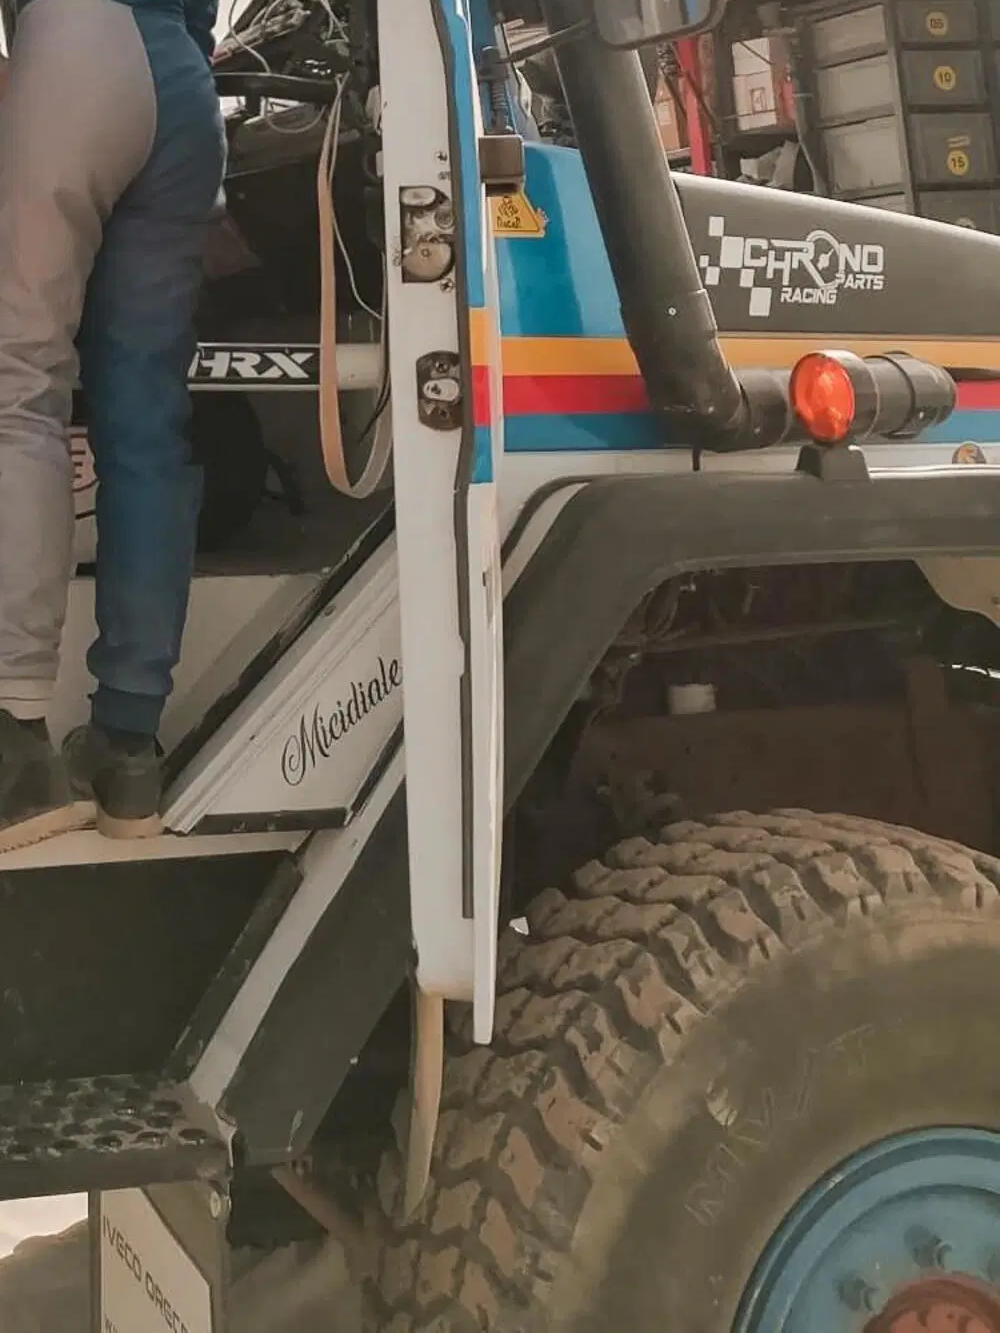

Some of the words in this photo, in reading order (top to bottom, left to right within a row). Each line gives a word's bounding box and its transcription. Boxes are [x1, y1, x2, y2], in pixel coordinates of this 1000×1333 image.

[780, 287, 838, 304] RACING
[835, 273, 884, 290] PARTS
[187, 351, 315, 379] HRX
[103, 1215, 143, 1283] IVECO
